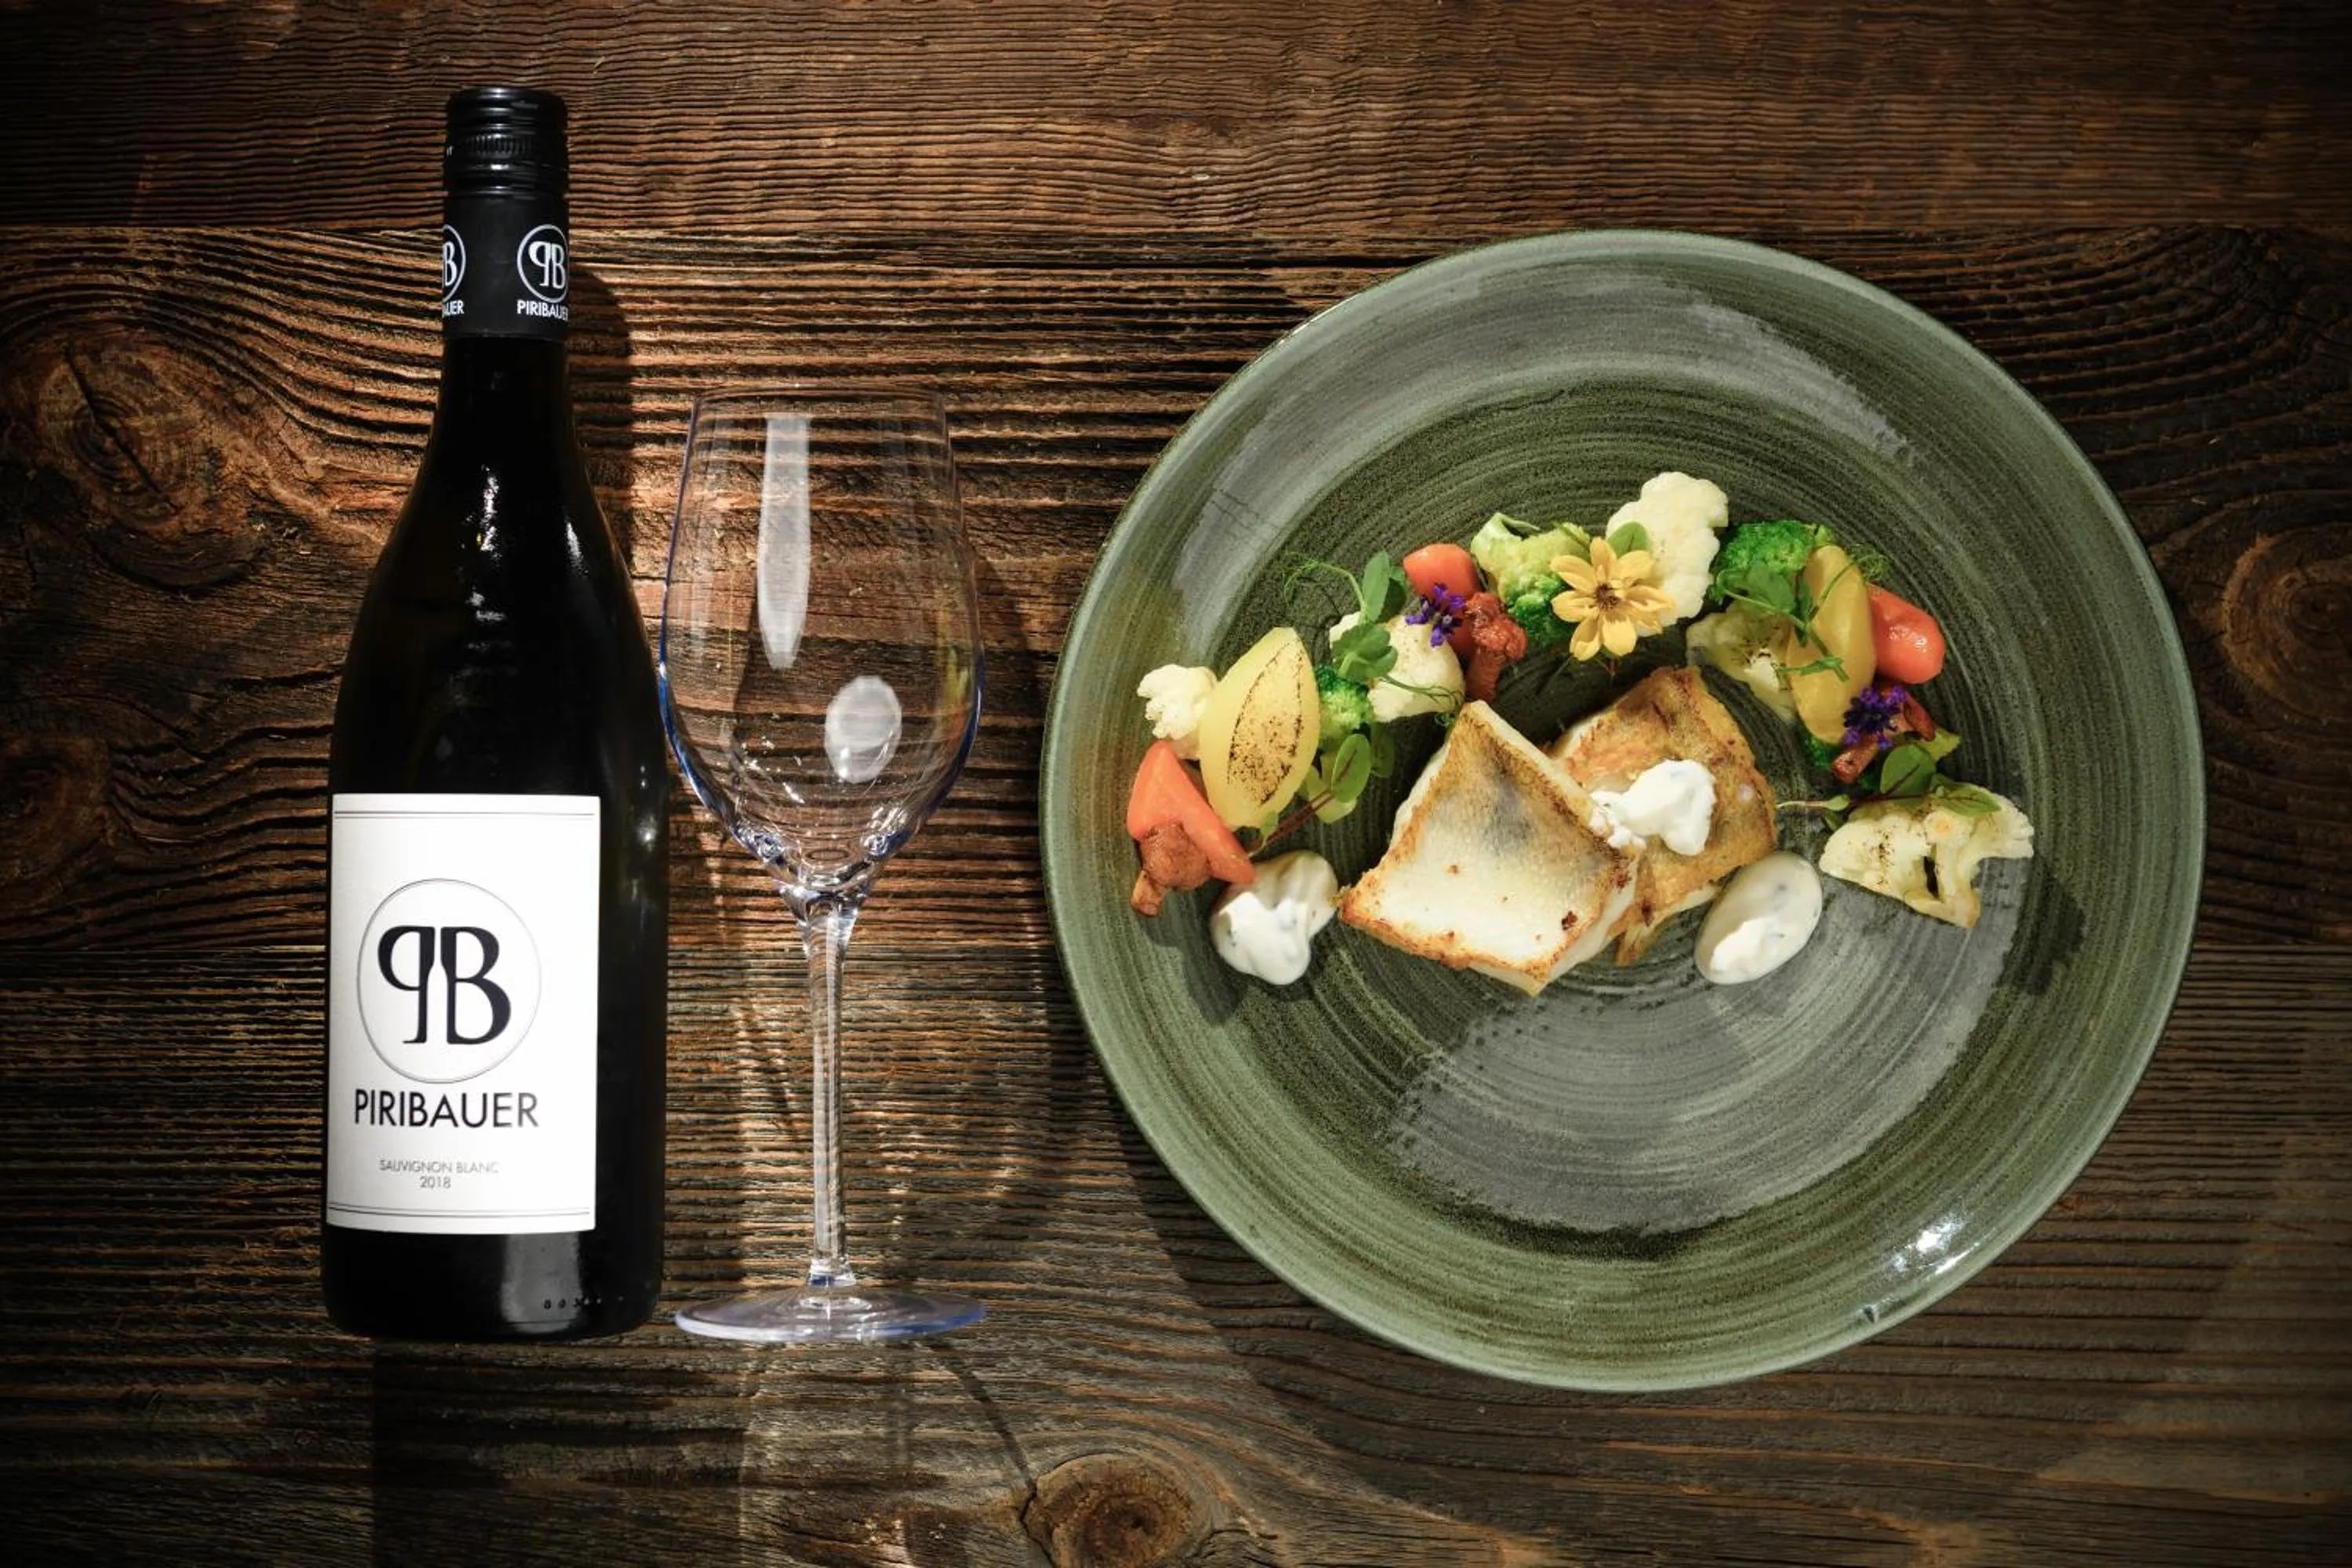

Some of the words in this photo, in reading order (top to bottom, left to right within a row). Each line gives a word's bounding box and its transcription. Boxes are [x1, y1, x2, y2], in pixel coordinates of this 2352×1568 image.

[442, 241, 458, 287] B
[517, 299, 568, 321] PIRIBAUE
[377, 925, 511, 1045] PB
[354, 1088, 539, 1128] PIRIBAUER
[379, 1160, 452, 1173] SAUVIGNON
[456, 1160, 499, 1174] BLANC
[419, 1176, 452, 1189] 2018
